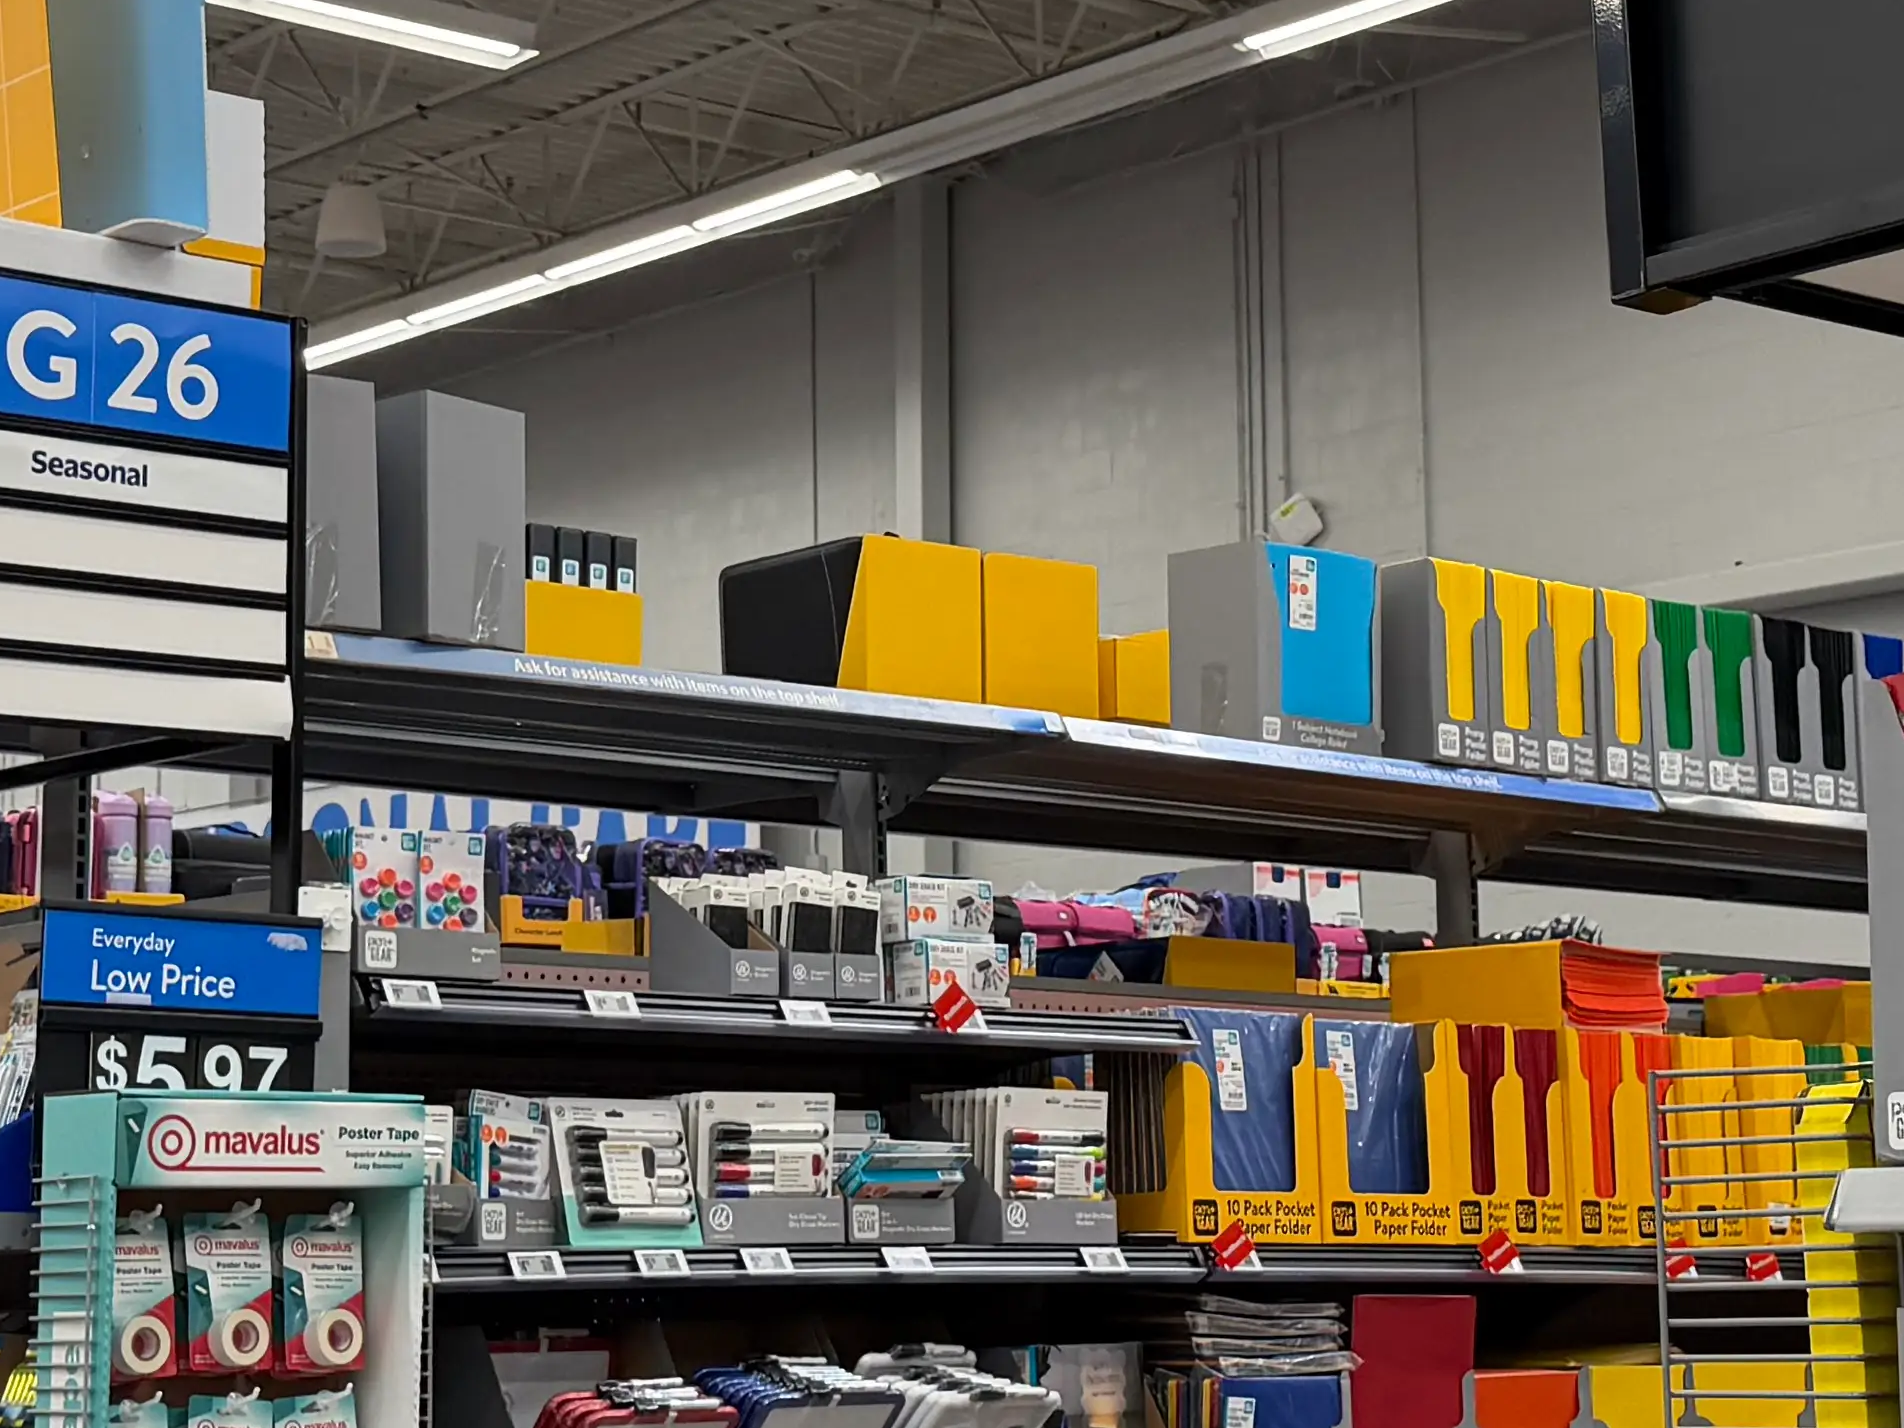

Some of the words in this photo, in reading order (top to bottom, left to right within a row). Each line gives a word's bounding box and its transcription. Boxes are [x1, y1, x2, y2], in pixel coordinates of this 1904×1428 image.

[5, 310, 76, 402] G
[109, 324, 220, 421] 26
[30, 448, 149, 491] Seasonal
[515, 658, 542, 675] Ask
[545, 662, 567, 678] for
[571, 666, 648, 685] assistance
[651, 673, 685, 691] with
[685, 678, 728, 695] items
[731, 685, 749, 698] on
[751, 685, 775, 701] the
[778, 690, 803, 708] top
[92, 928, 176, 955] Everyday
[91, 959, 151, 996] Low
[161, 964, 236, 999] Price
[204, 1125, 321, 1156] mavalus
[338, 1126, 382, 1140] Poster
[386, 1128, 419, 1141] Tape
[1365, 1201, 1377, 1216] 10
[1380, 1201, 1409, 1218] Pack
[1412, 1203, 1450, 1219] Pocket
[1375, 1220, 1408, 1238] Paper
[1412, 1220, 1446, 1236] Folder
